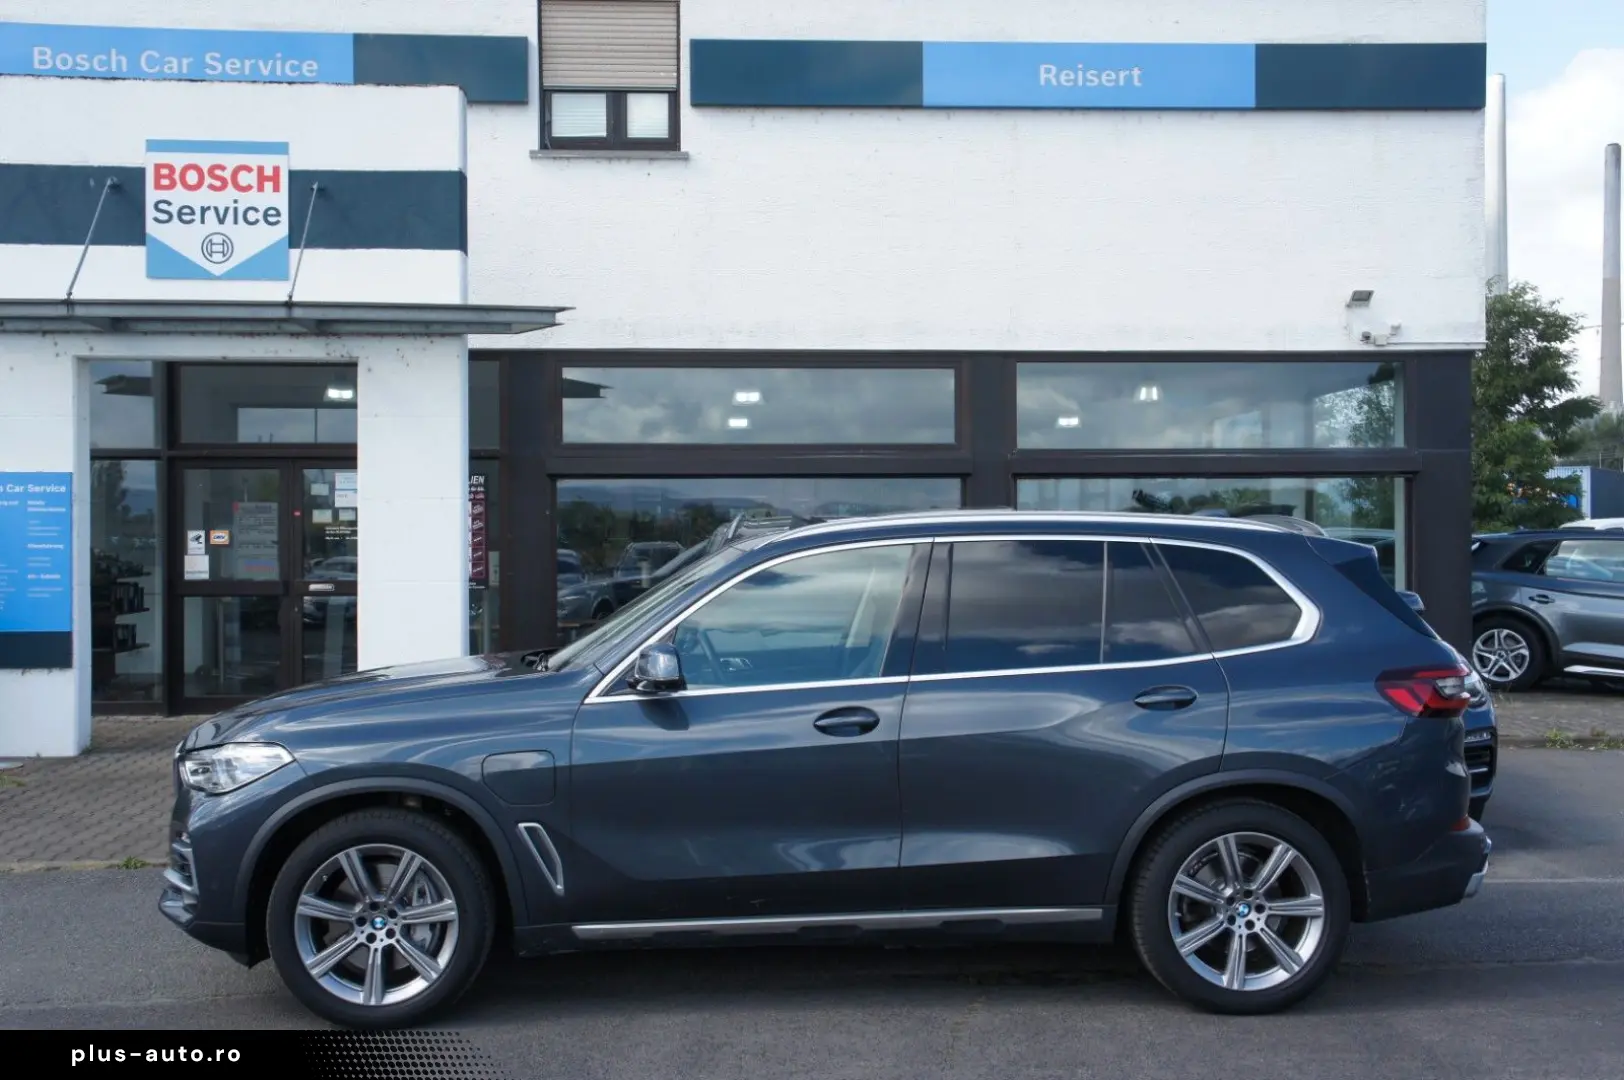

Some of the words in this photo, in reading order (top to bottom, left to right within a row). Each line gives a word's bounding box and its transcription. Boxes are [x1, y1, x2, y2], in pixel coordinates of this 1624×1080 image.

[32, 46, 127, 72] Bosch
[140, 50, 193, 74] Car
[204, 52, 319, 77] Service
[1039, 64, 1143, 87] Reisert
[153, 162, 281, 193] BOSCH
[152, 199, 282, 226] Service
[6, 484, 25, 493] Car
[27, 483, 67, 493] Service
